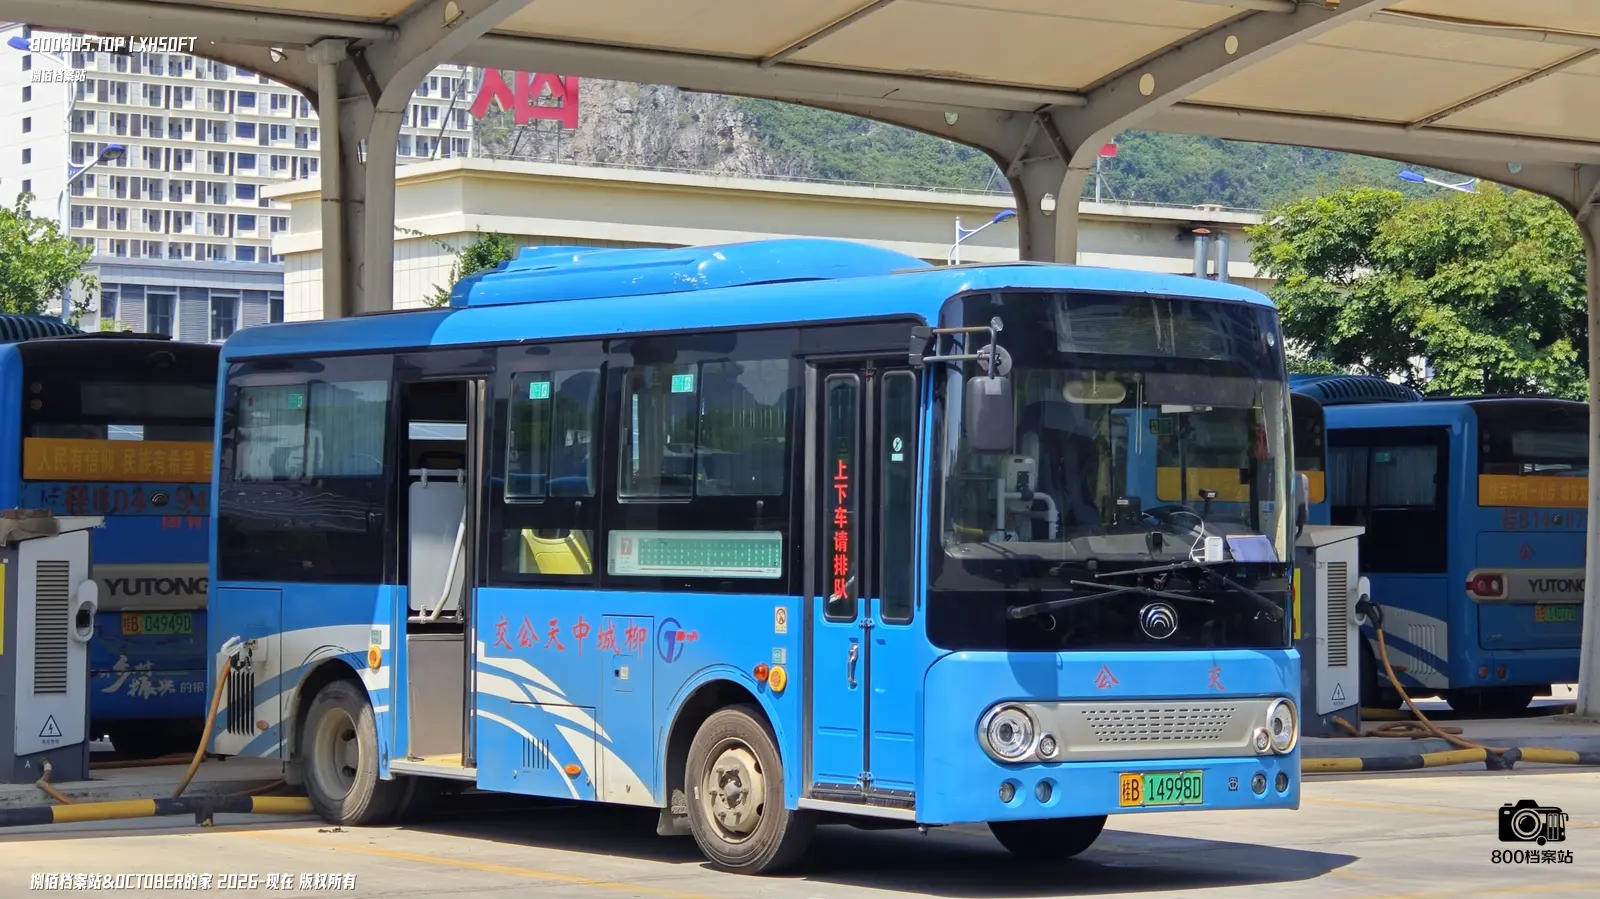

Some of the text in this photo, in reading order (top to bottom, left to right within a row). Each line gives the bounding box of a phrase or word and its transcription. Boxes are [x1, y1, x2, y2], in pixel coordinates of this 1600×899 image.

[37, 448, 115, 473] 人民有信仰
[123, 449, 195, 475] 民族有希望
[833, 459, 849, 599] 上下车请排队
[104, 578, 208, 596] YUTONG
[1094, 659, 1225, 691] 公 交
[1148, 777, 1201, 801] 14998D
